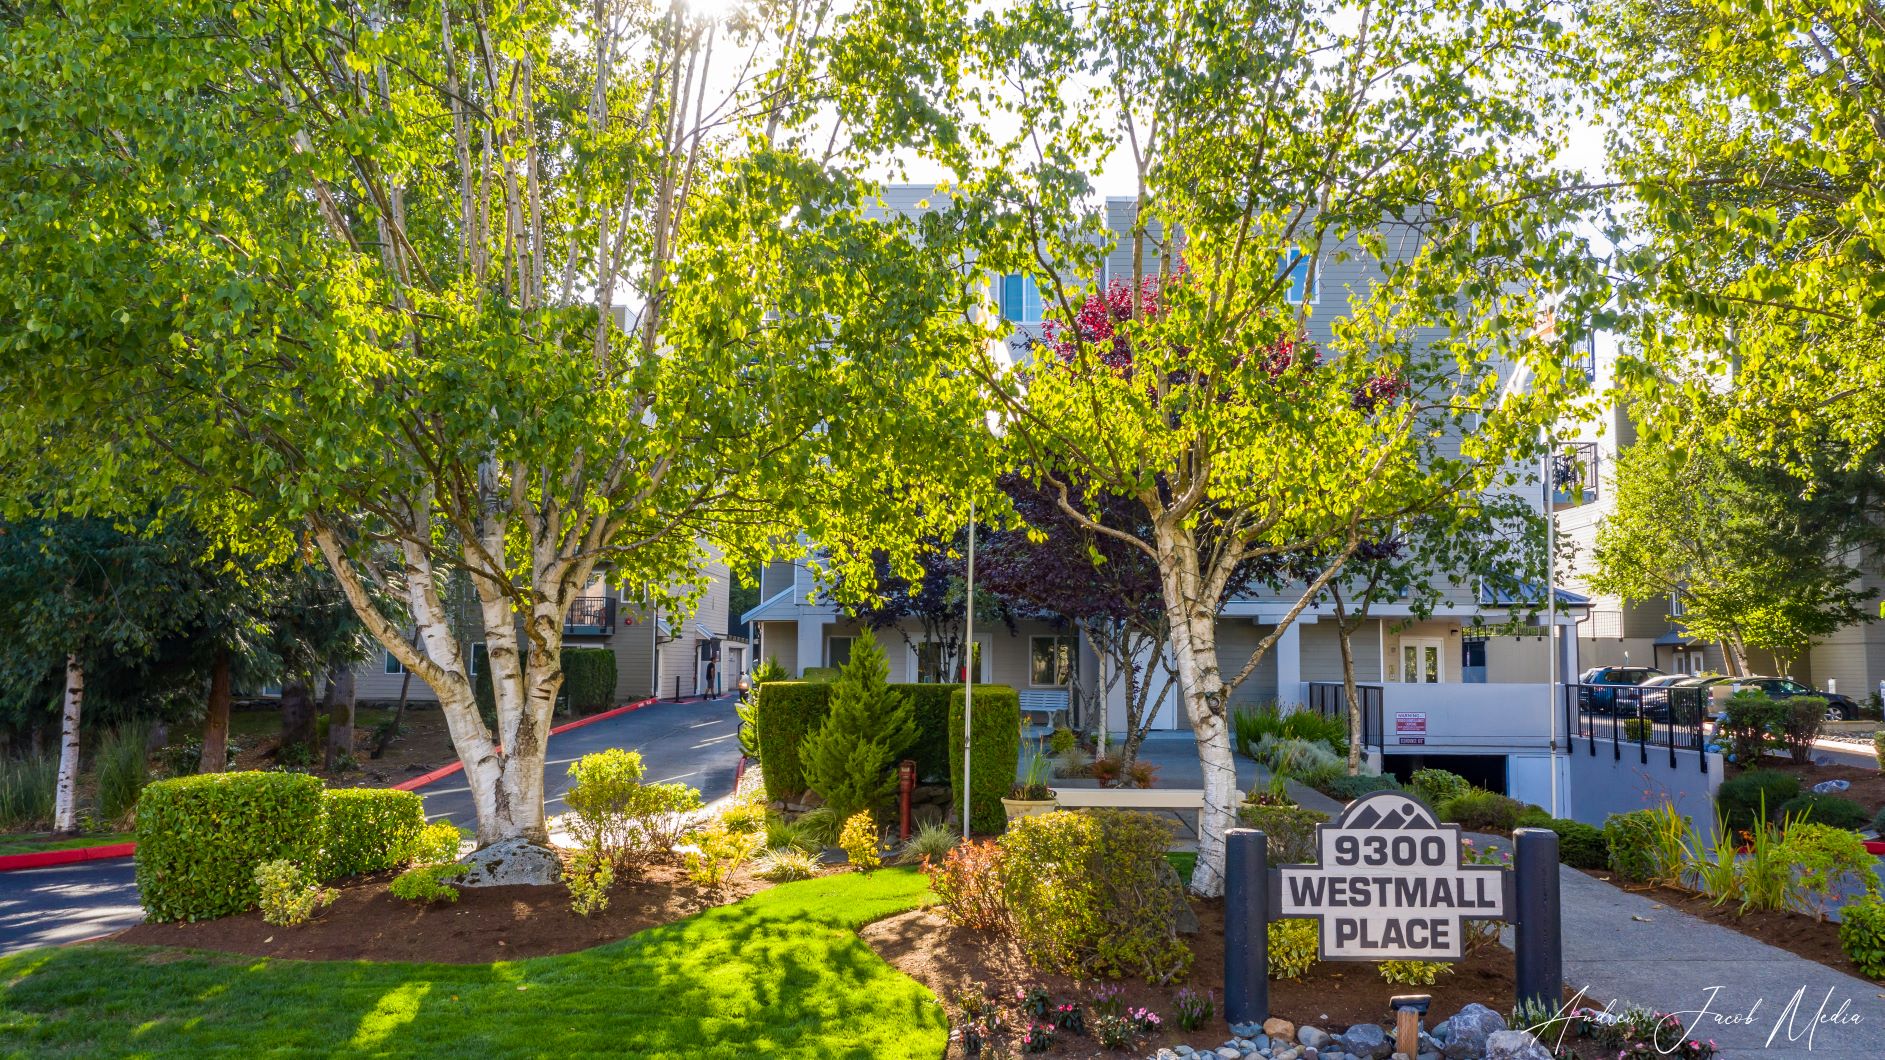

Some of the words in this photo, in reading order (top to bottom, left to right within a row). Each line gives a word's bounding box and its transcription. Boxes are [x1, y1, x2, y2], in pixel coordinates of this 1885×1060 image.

[1335, 836, 1446, 866] 9300
[1289, 876, 1496, 908] WESTMALL
[1336, 918, 1450, 949] PLACE
